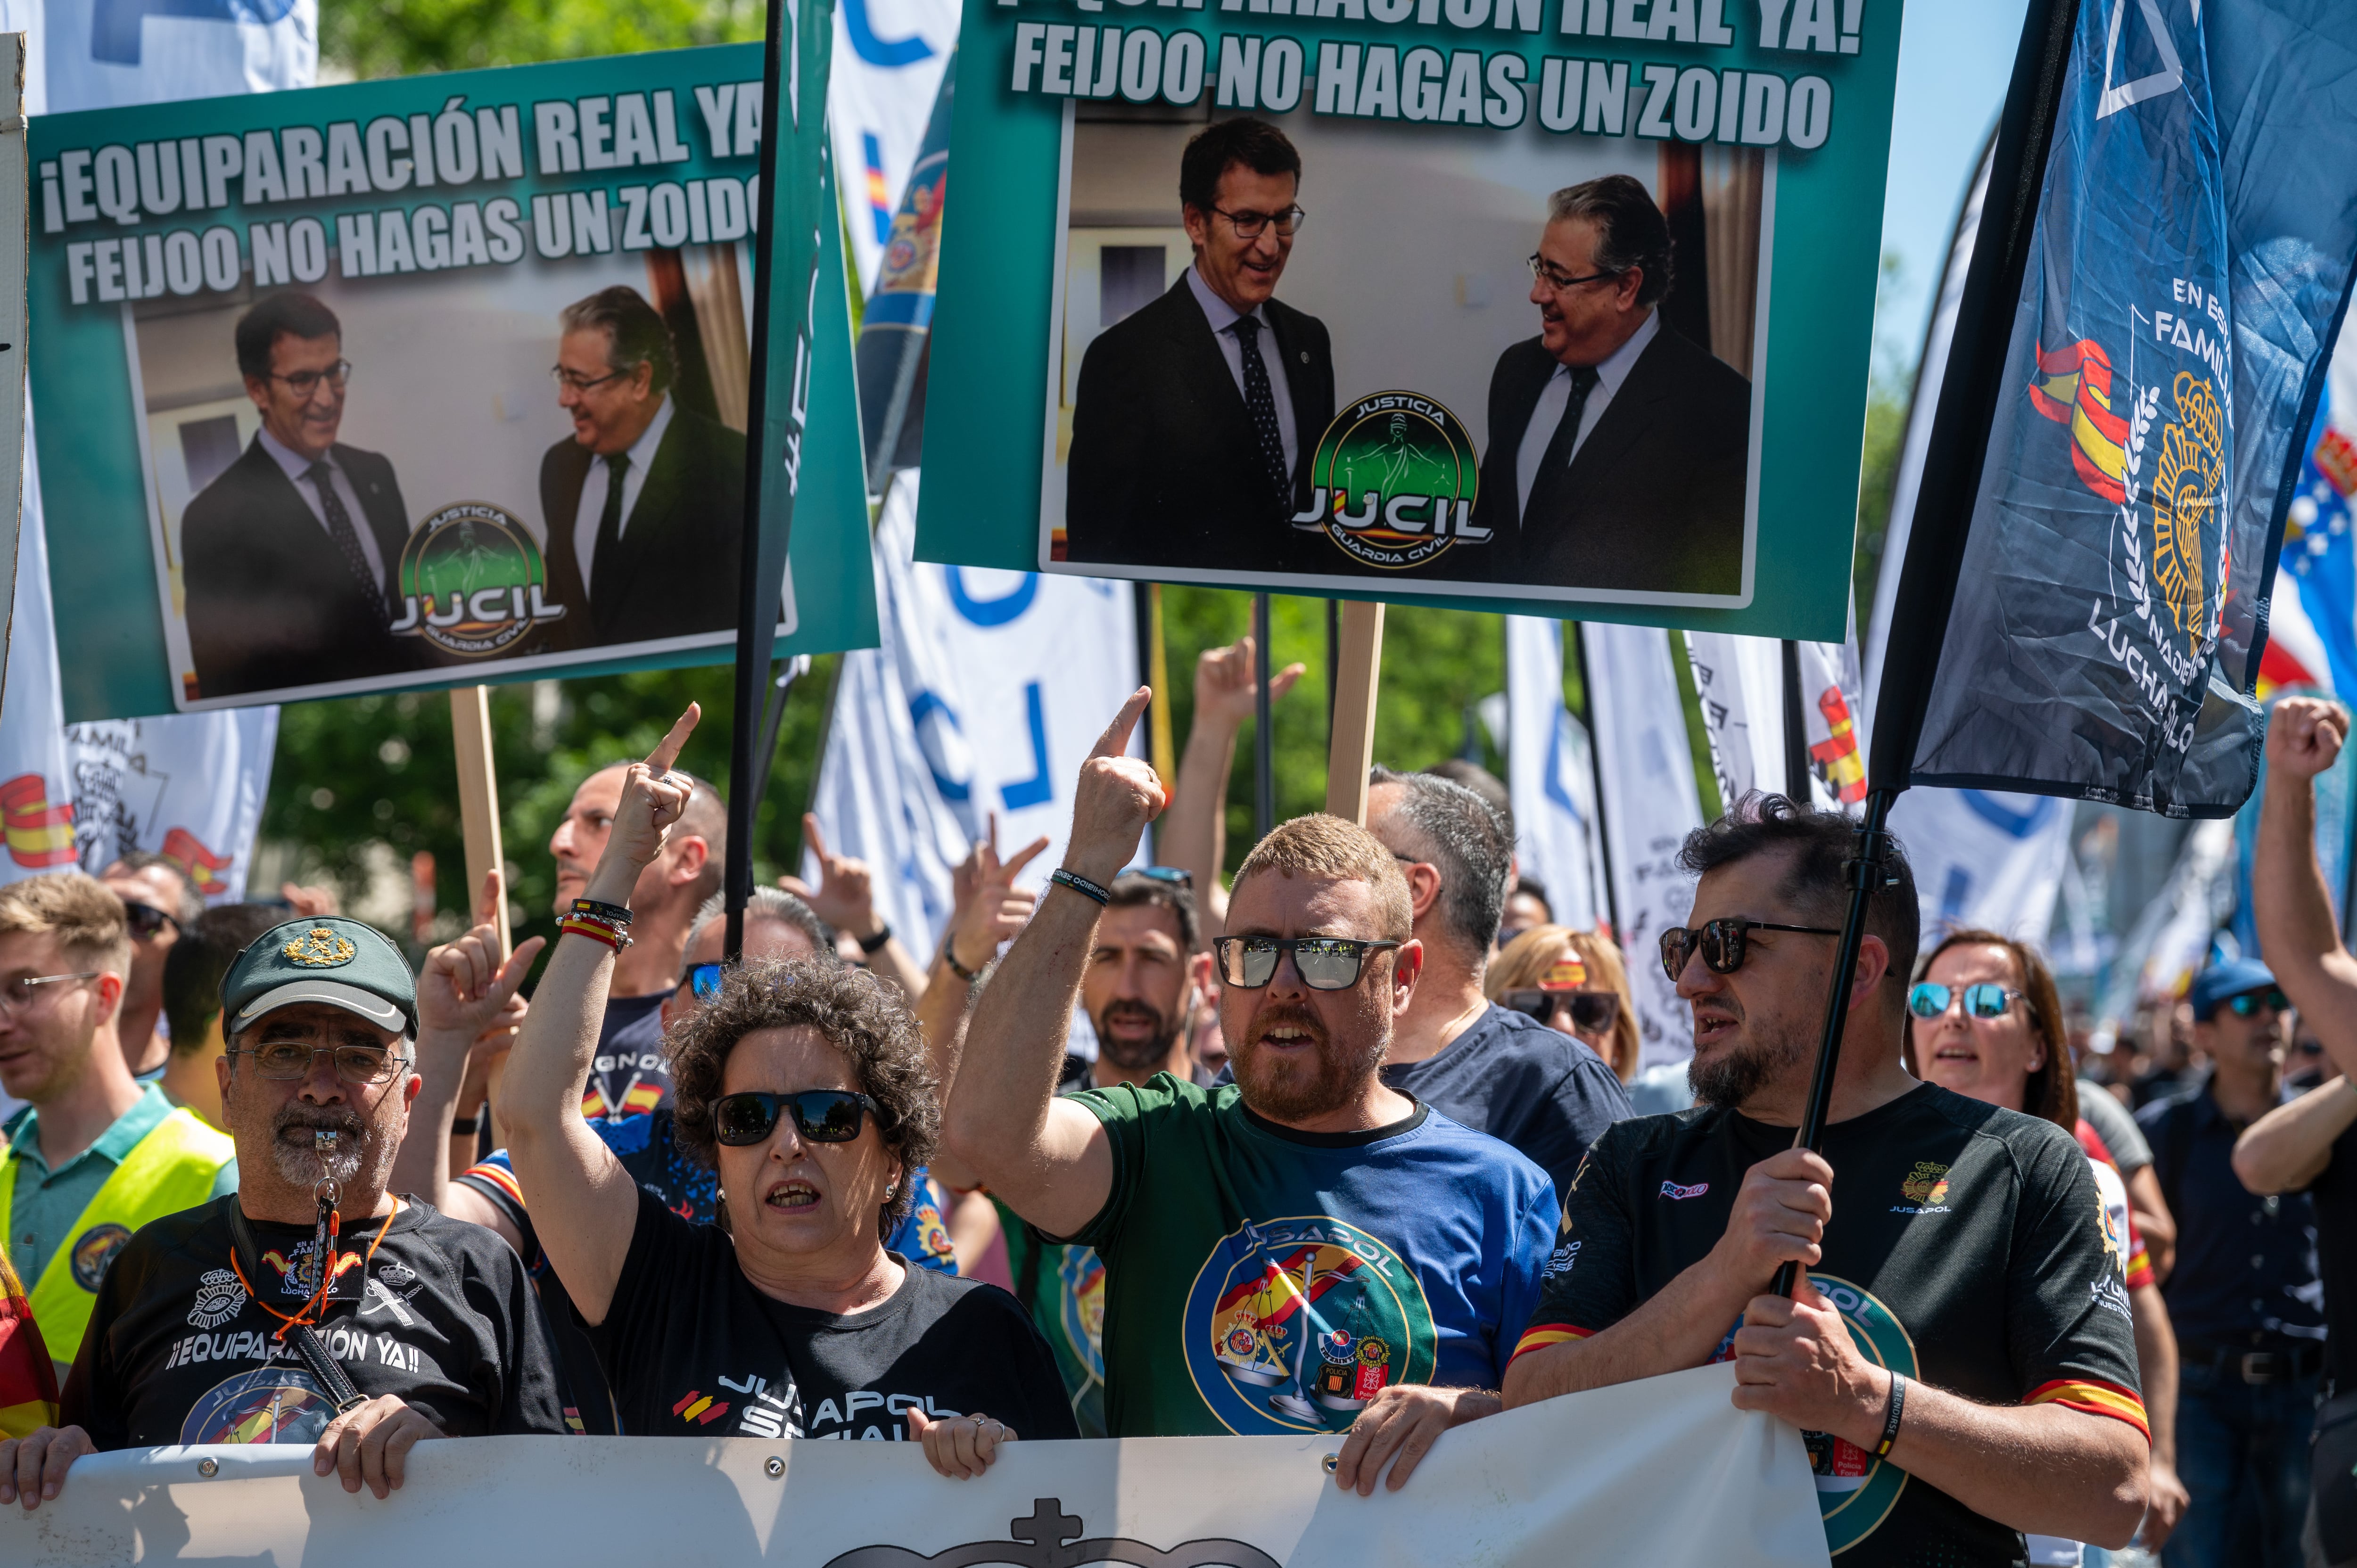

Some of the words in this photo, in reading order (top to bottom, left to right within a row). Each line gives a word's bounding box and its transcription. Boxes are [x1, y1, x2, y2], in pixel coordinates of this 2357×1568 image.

[1012, 22, 1205, 104] FEIJOO
[1217, 34, 1304, 111] NO
[1315, 42, 1527, 128] HAGAS
[1540, 58, 1628, 134] UN
[1638, 65, 1832, 149] ZOIDO
[40, 96, 524, 233] ¡EQUIPARACIÓN
[534, 90, 689, 175] REAL
[67, 227, 240, 305] FEIJOO
[249, 218, 327, 287] NO
[337, 198, 524, 278] HAGAS
[532, 190, 611, 259] UN
[2173, 278, 2201, 309] EN
[1356, 396, 1444, 426] JUSTICIA
[429, 505, 507, 533] JUSTICIA
[1291, 488, 1492, 538] JUCIL
[1331, 523, 1404, 563] GUARDIA
[1408, 536, 1449, 560] CIVIL
[389, 584, 565, 631] JUCIL
[425, 624, 494, 650] GUARDIA
[496, 617, 530, 645] CIVIL
[1889, 1206, 1952, 1214] JUSAPOL
[1245, 1224, 1393, 1277] JUSAPOL
[375, 1337, 419, 1373] YA!!
[1326, 1368, 1348, 1376] POLICIA
[718, 1374, 962, 1428] JUAPOL
[1887, 1391, 1902, 1436] RENDIRSE
[1838, 1461, 1862, 1470] Policía
